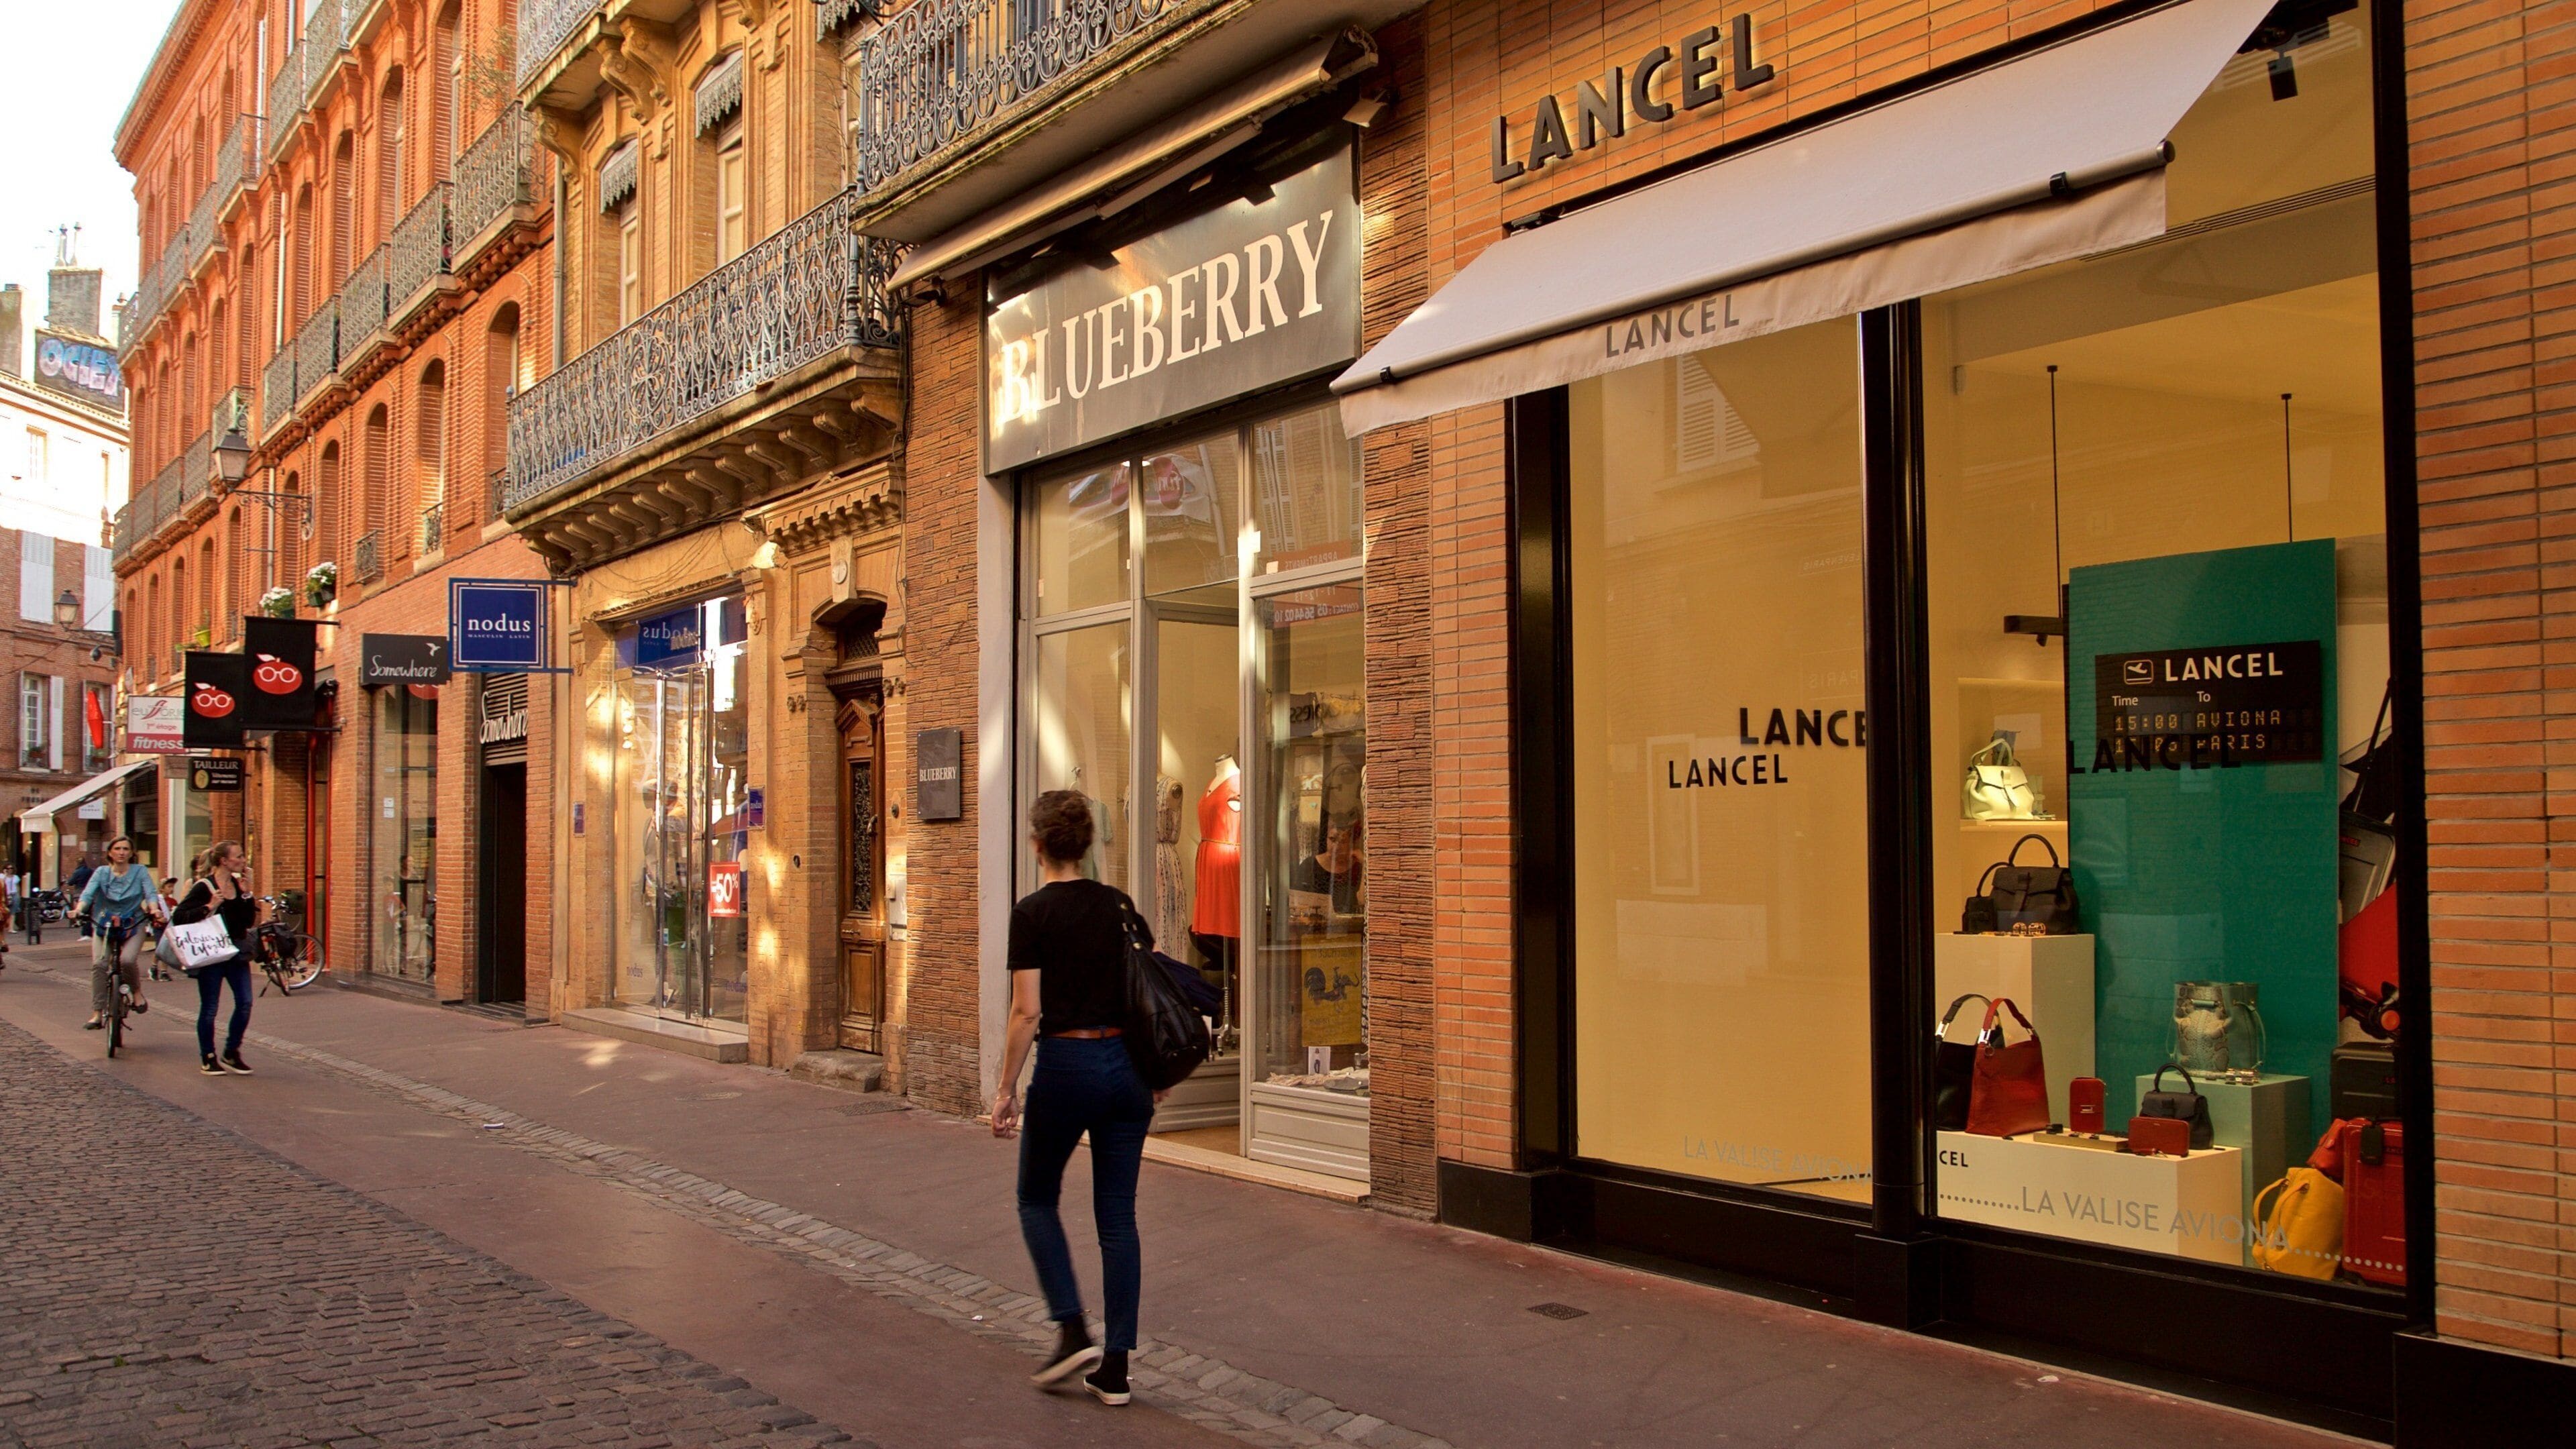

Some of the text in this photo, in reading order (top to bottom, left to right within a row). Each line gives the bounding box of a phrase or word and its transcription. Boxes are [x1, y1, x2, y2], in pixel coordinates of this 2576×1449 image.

[1491, 13, 1774, 183] LANCEL
[997, 209, 1334, 425] BLUEBERRY
[1606, 294, 1740, 358] LANCEL
[468, 612, 531, 632] nodus
[369, 655, 437, 678] Somewhere
[2165, 652, 2284, 682] LANCEL
[2112, 691, 2211, 706] Time To
[480, 691, 528, 744] Somewhere
[2115, 709, 2281, 731] 15:00 AVIONA
[133, 736, 184, 749] fitness
[2068, 733, 2241, 774] LANCEL
[193, 760, 238, 769] TAILLEUR
[919, 766, 957, 782] BLUEBERRY
[1668, 754, 1788, 789] LANCEL
[1684, 1135, 1709, 1161] LA
[1715, 1140, 1783, 1174] VALISE
[1939, 1150, 1969, 1167] CEL
[2022, 1186, 2293, 1253] LA VALISE AVIONA
